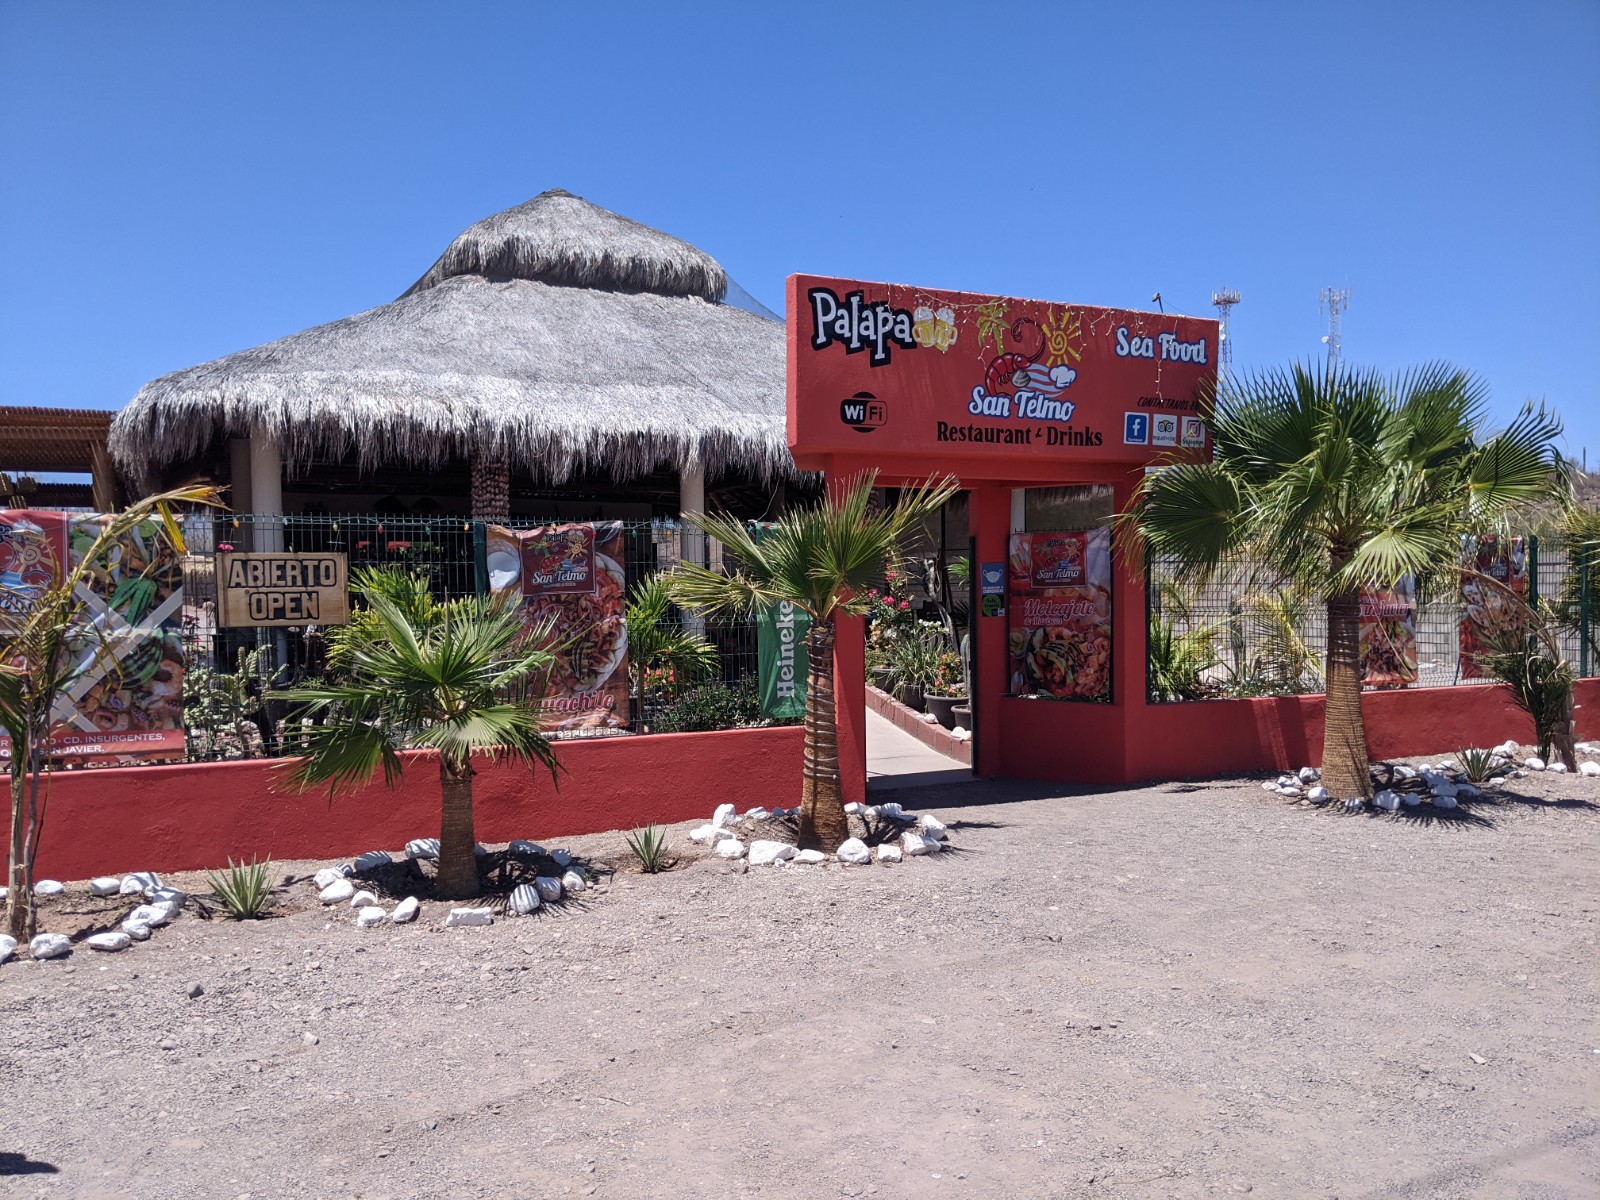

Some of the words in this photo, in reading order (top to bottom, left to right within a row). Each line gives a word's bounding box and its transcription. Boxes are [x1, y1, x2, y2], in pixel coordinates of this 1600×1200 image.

[808, 288, 917, 367] Palapa
[1115, 327, 1155, 358] Sea
[1158, 333, 1208, 364] Food
[968, 385, 1011, 418] San
[1014, 391, 1075, 422] Telmo
[936, 421, 1032, 445] Restaurant
[1046, 425, 1103, 447] Drinks
[228, 559, 337, 588] ABIERTO
[532, 571, 553, 584] San
[555, 569, 587, 582] Telmo
[249, 591, 319, 620] OPEN
[1024, 599, 1095, 620] Molcajete
[776, 598, 795, 698] Heineke
[64, 736, 83, 745] CD.
